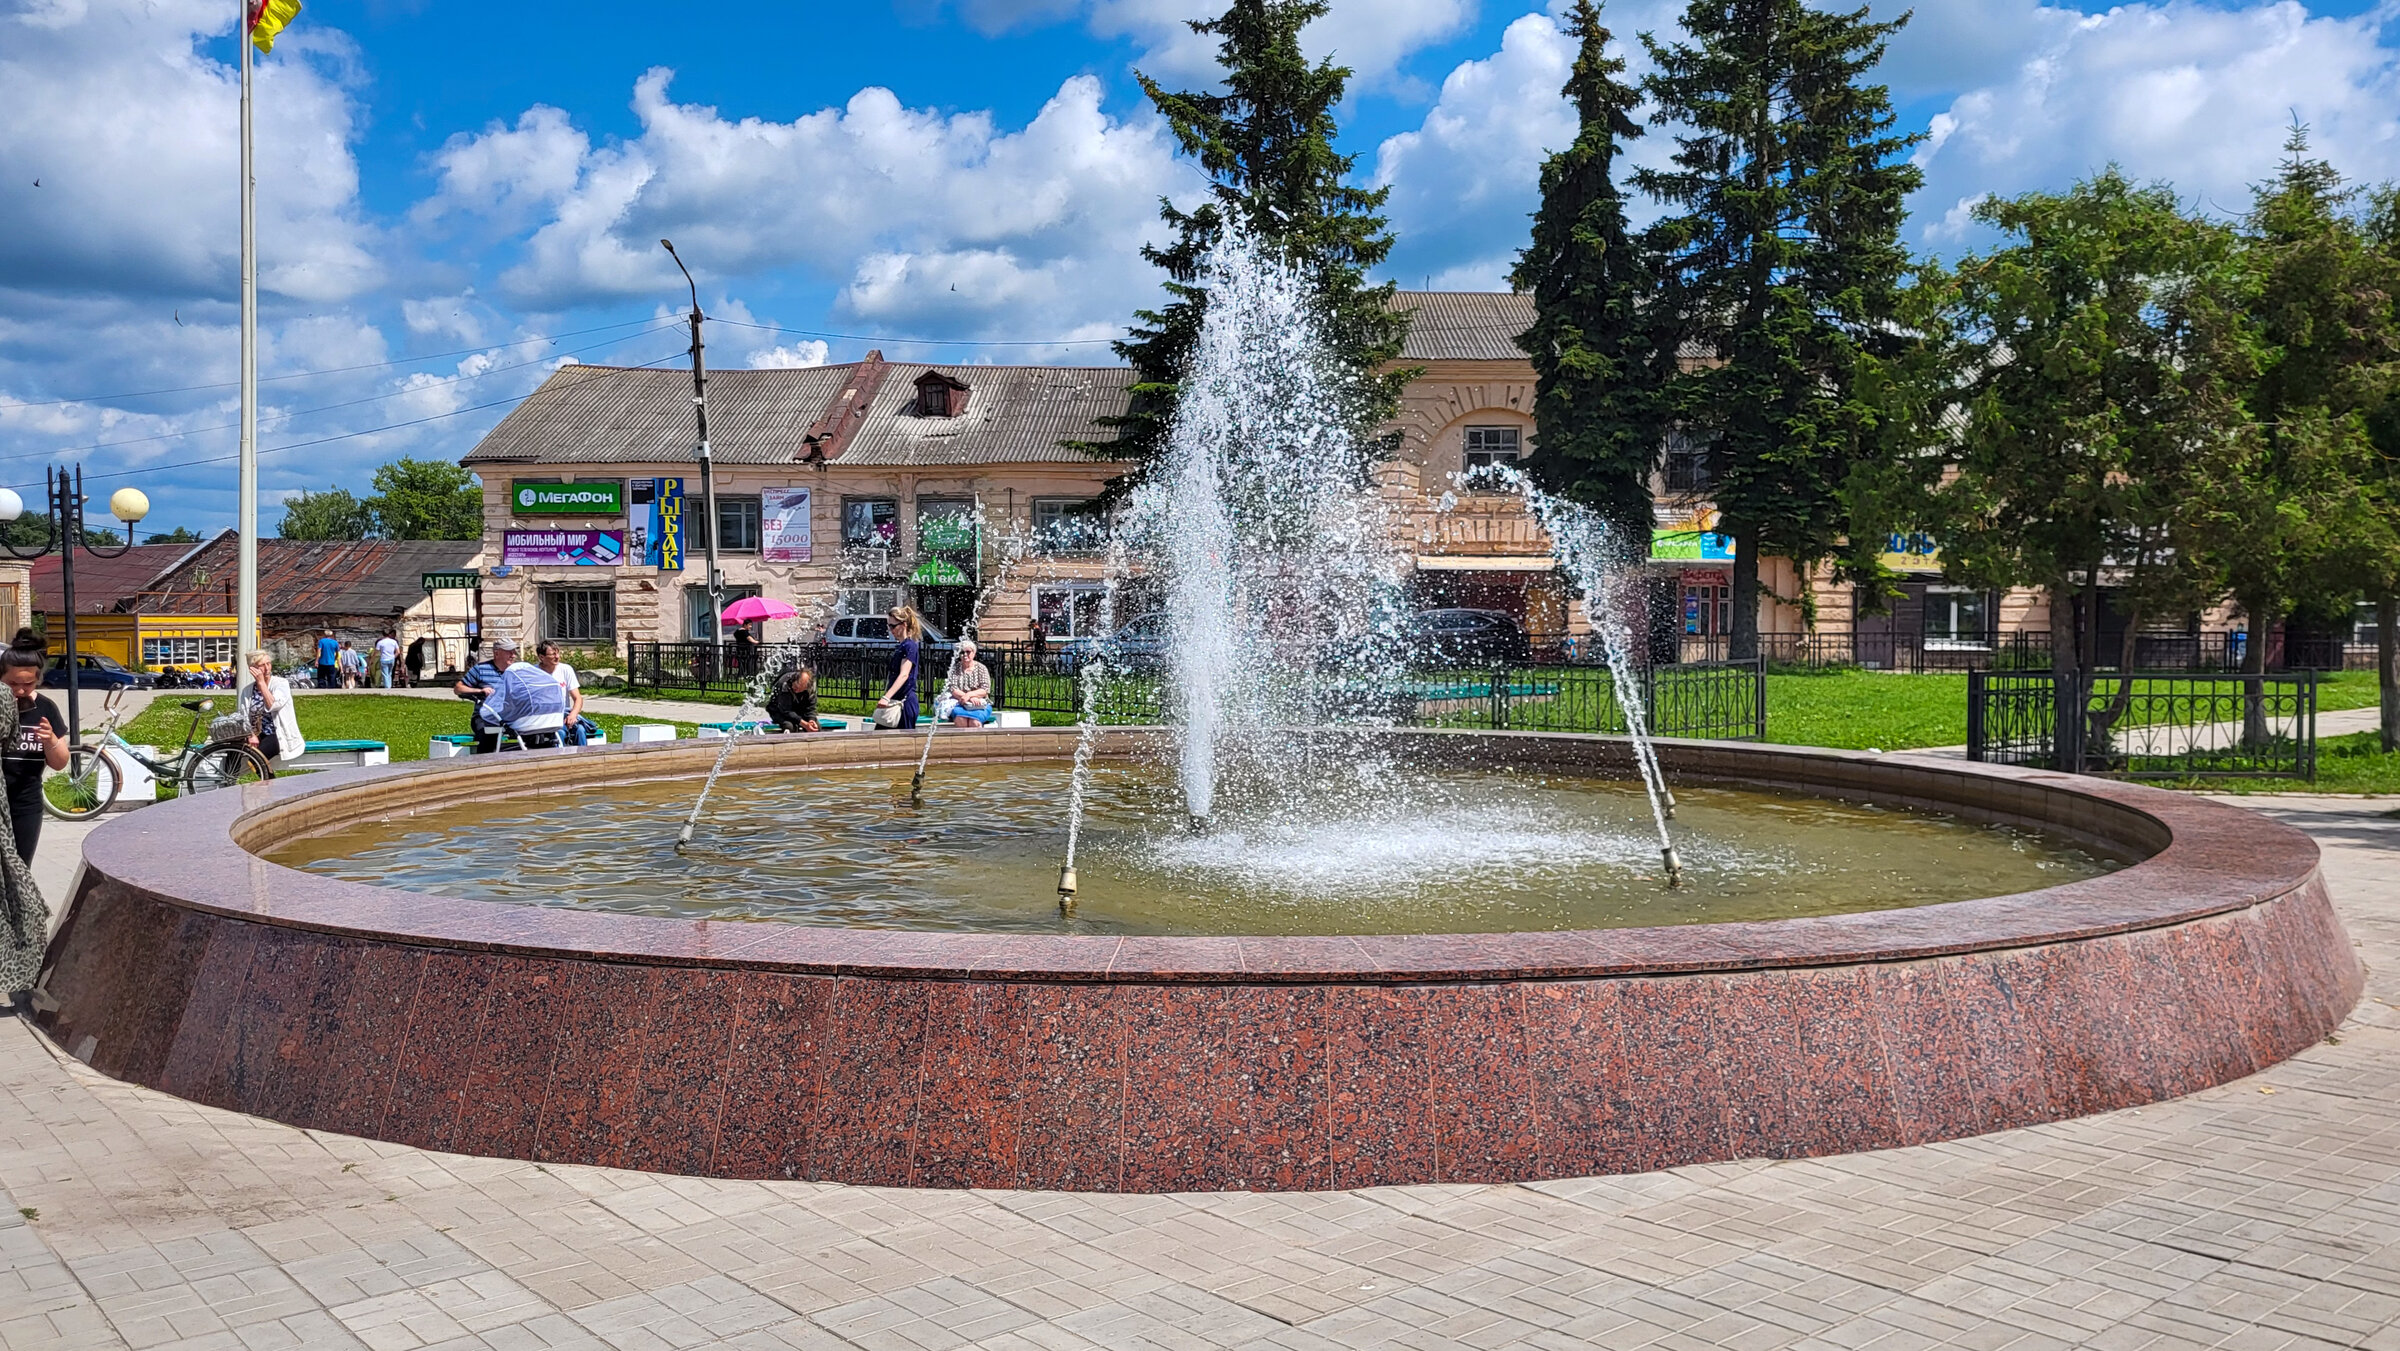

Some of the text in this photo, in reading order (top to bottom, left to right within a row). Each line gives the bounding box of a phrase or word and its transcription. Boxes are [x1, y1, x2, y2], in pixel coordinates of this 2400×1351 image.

[659, 479, 682, 569] РЫБАК
[763, 519, 782, 530] БЕЗ
[507, 533, 587, 546] МОБИЛЬНЫЙ МИР
[771, 534, 808, 545] 15000
[424, 576, 481, 588] АПТЕКА
[17, 742, 44, 751] ONE
